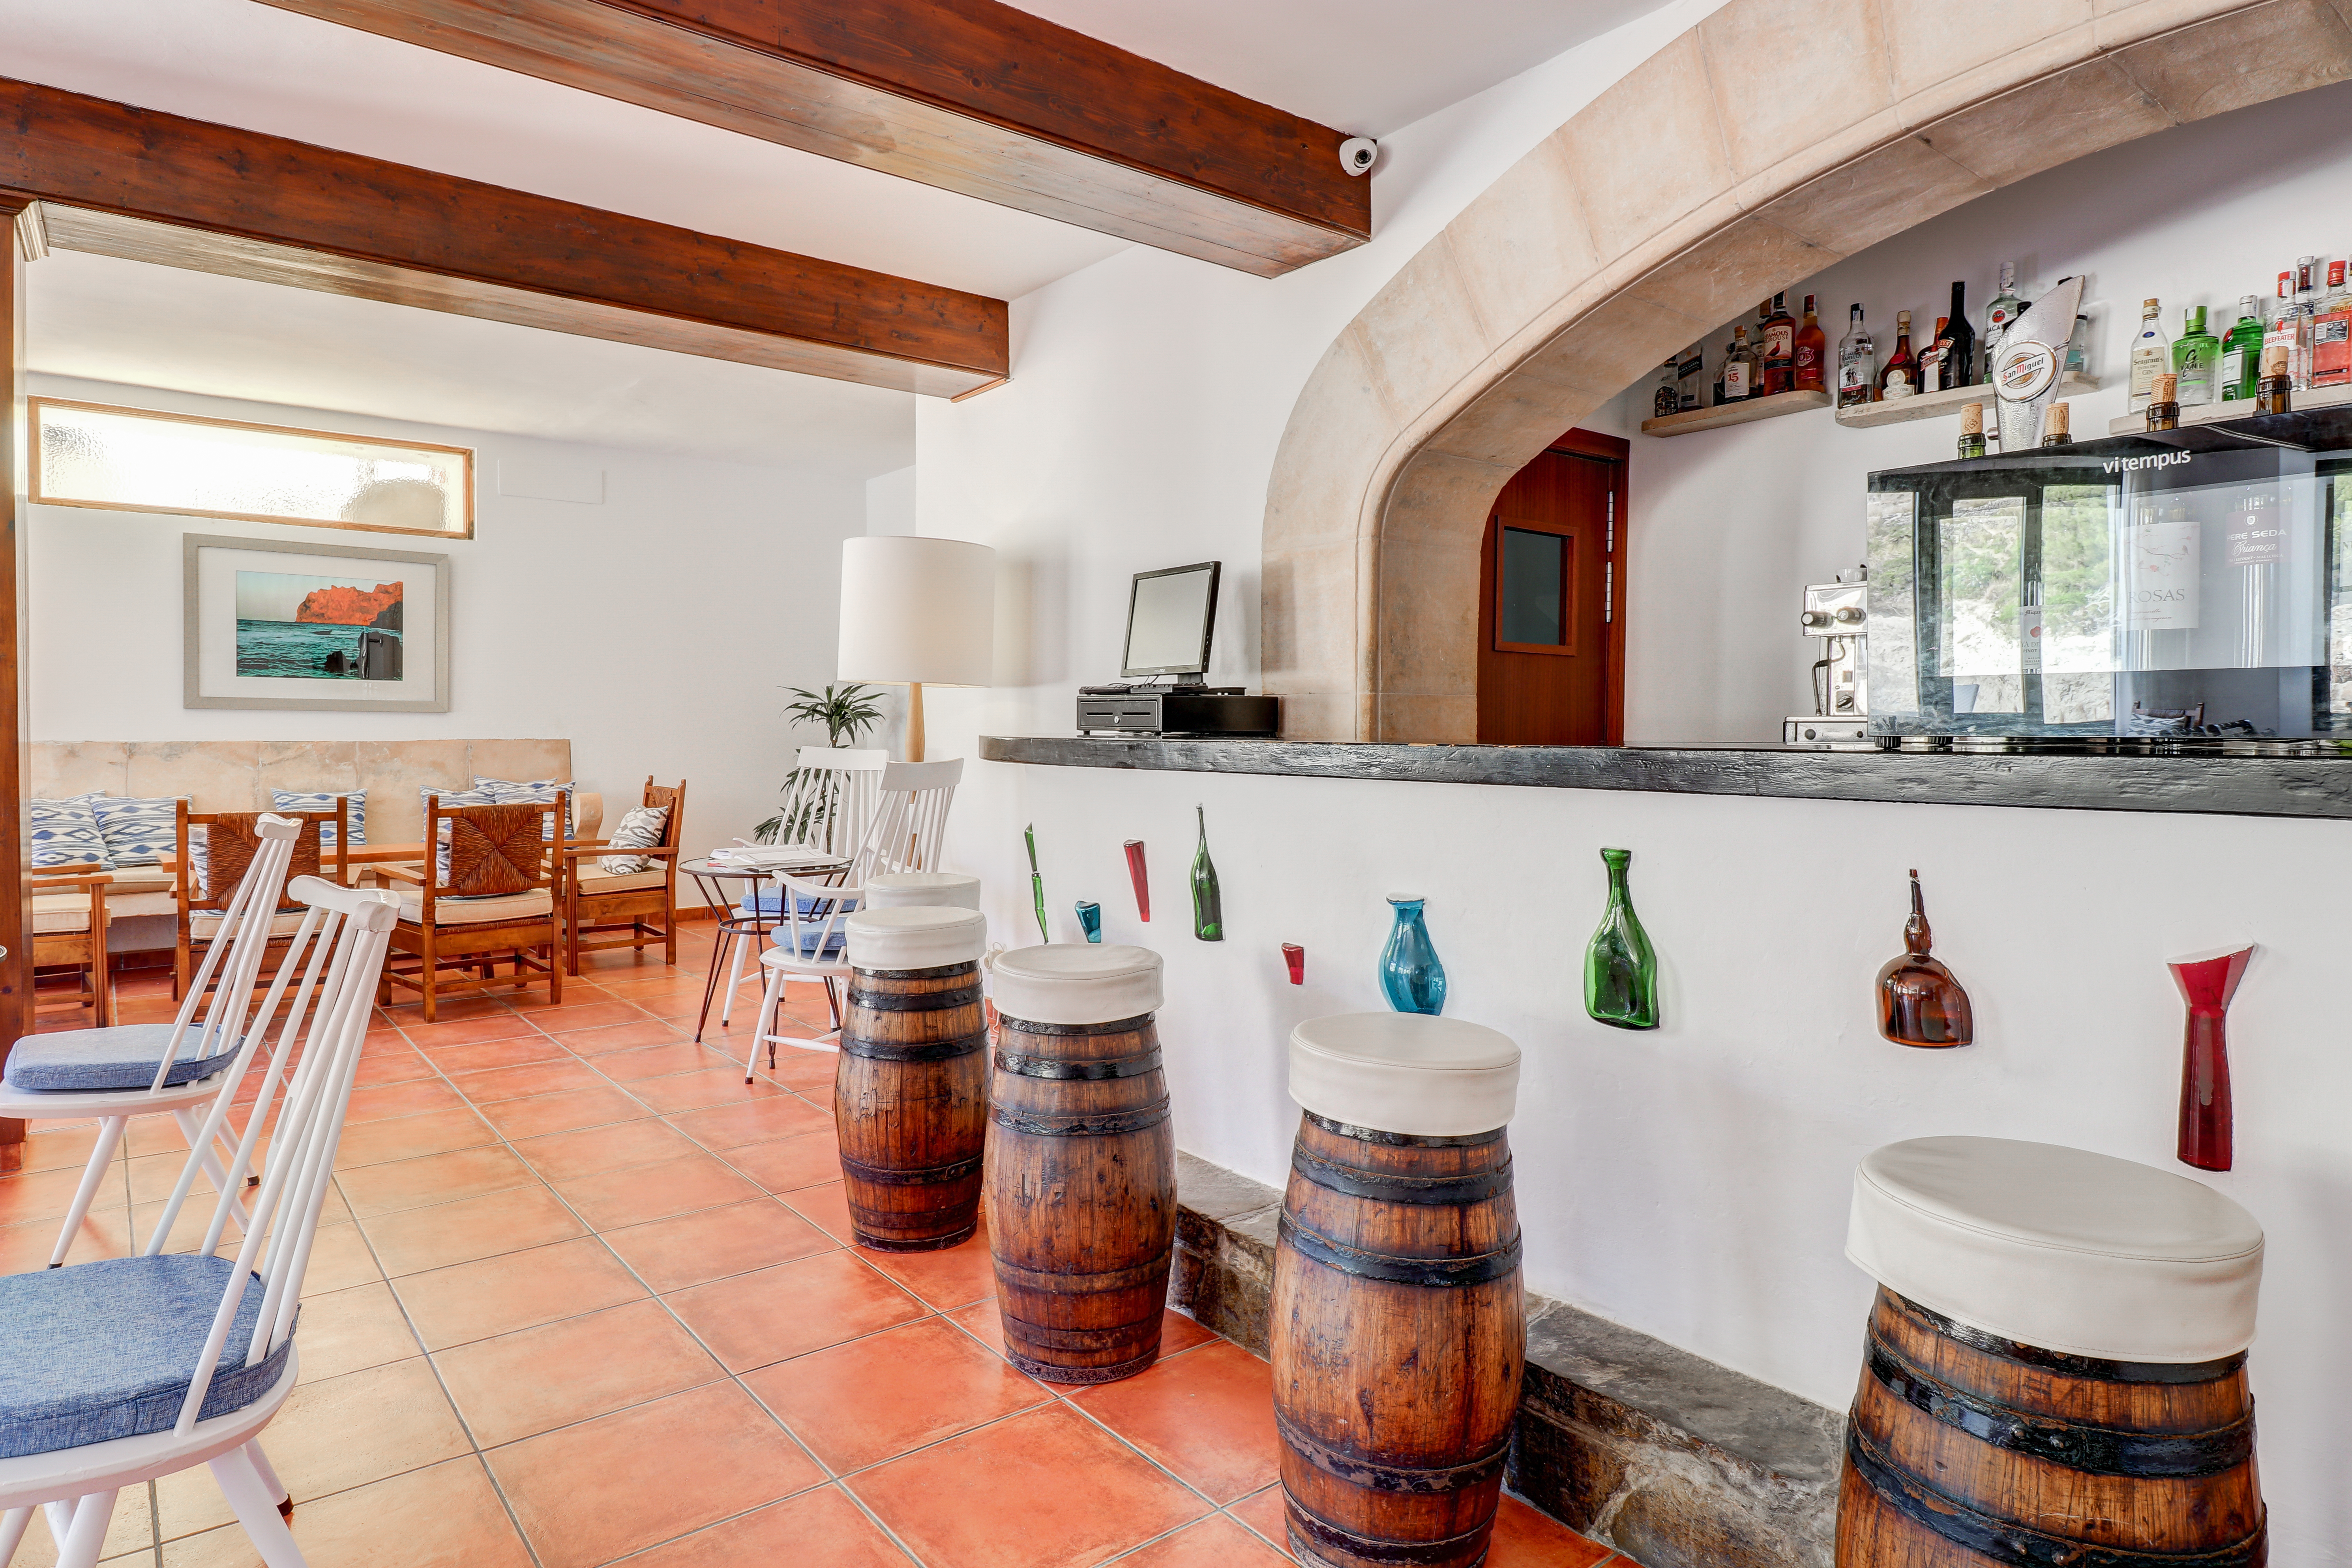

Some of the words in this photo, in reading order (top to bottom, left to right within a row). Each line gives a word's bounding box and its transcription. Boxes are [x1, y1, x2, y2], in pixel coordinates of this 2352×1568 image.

[1987, 325, 2000, 333] BACA
[2264, 333, 2295, 345] BEEFEATER
[2133, 356, 2163, 365] Seagram's
[1728, 372, 1738, 382] 15
[2227, 532, 2248, 541] PERE
[2251, 529, 2286, 538] SEDA
[2231, 540, 2277, 557] Criança
[2129, 588, 2185, 603] ROSAS
